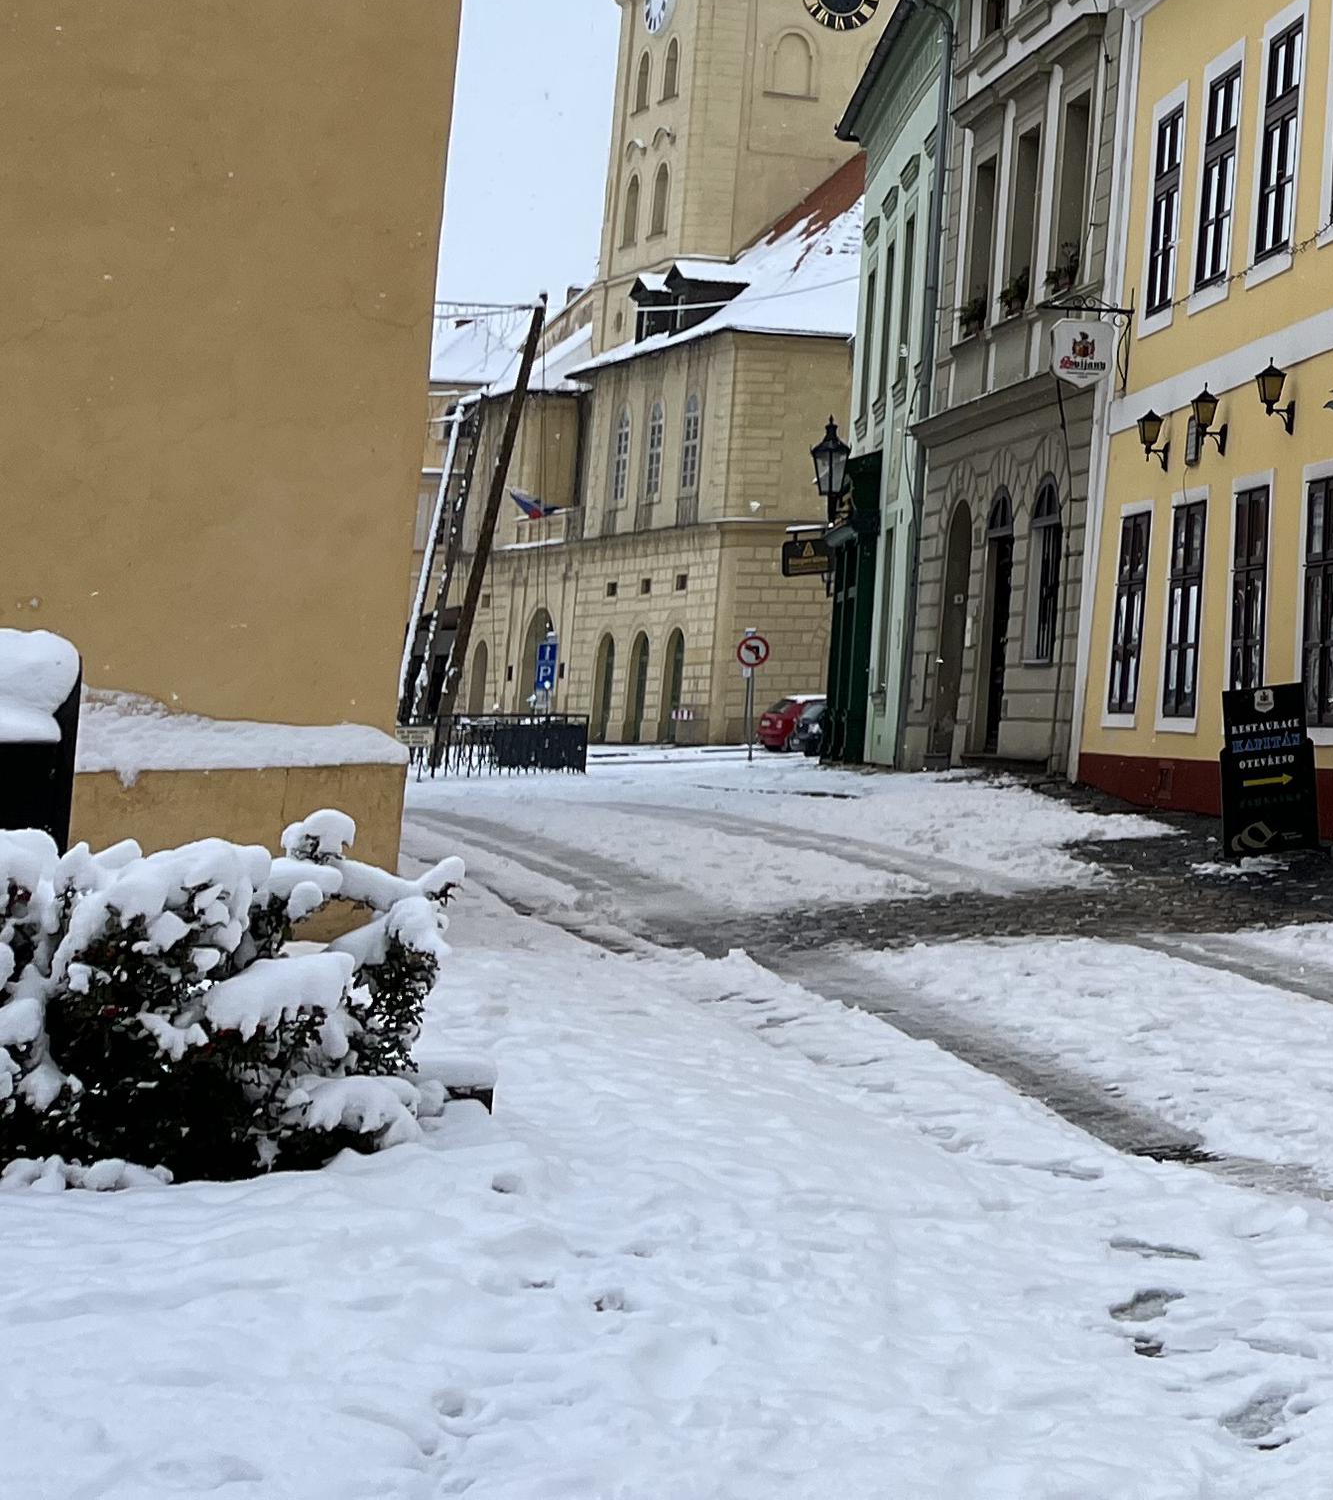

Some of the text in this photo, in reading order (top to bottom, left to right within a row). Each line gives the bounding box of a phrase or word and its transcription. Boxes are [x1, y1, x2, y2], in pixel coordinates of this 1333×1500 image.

[539, 666, 551, 681] P
[1231, 718, 1300, 735] RESTAURACE
[1232, 731, 1301, 753] KAPITÁN
